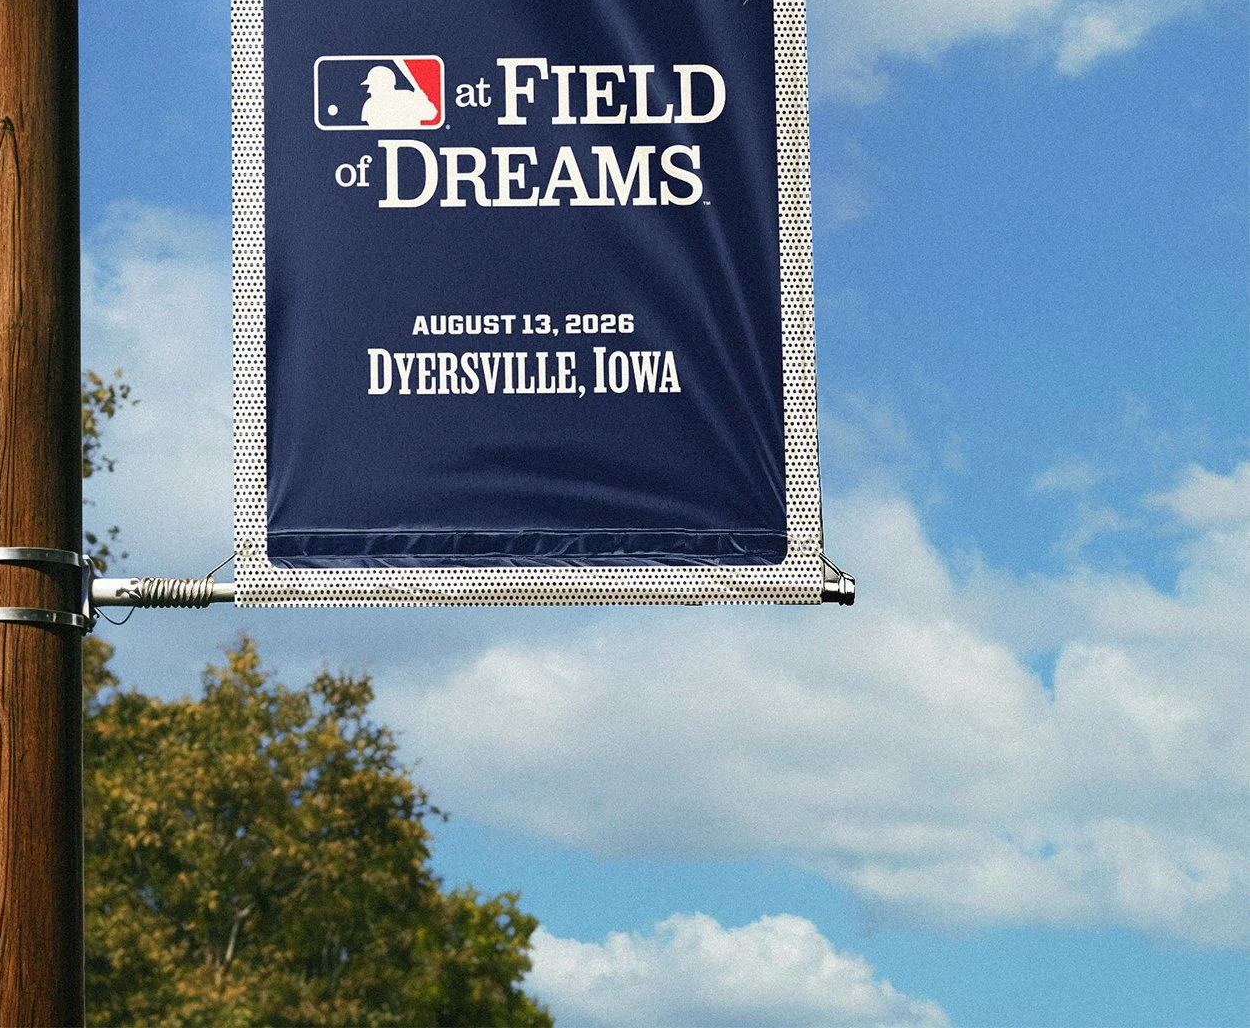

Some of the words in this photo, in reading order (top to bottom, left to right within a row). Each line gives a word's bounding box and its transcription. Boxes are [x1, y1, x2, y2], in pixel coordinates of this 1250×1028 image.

[454, 77, 493, 109] at
[496, 57, 727, 126] FIELD
[334, 154, 374, 188] of
[377, 139, 704, 208] DREAMS
[411, 314, 517, 336] AUGUST
[521, 314, 560, 337] 13,
[565, 313, 635, 335] 2026
[367, 348, 587, 399] DYERSVILLE,
[593, 346, 682, 395] IOWA
